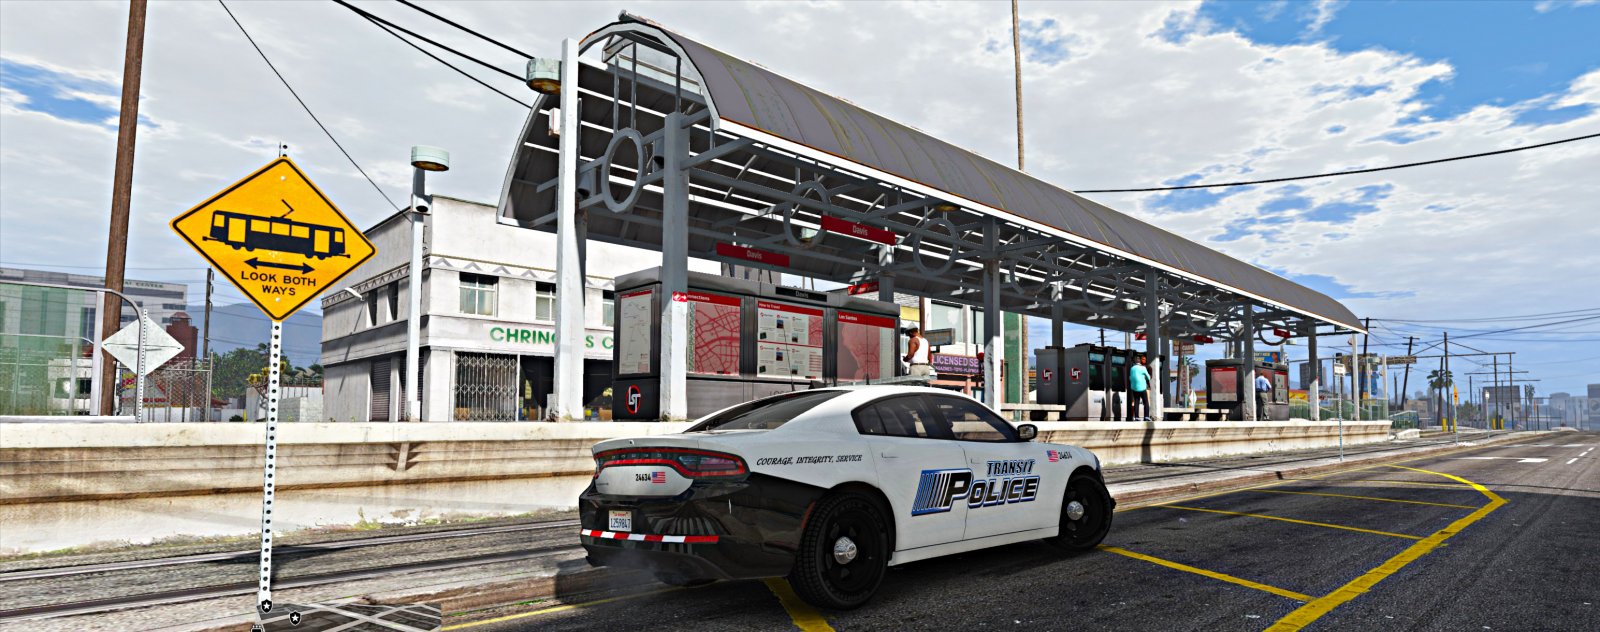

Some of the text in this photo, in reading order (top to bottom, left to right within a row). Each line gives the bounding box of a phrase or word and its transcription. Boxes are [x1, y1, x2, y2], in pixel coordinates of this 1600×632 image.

[852, 225, 869, 237] Davis
[746, 249, 763, 260] Davis
[241, 270, 316, 287] LOOK BOTH
[262, 284, 296, 296] WAYS
[795, 290, 809, 299] Davis
[687, 294, 710, 302] onnections
[934, 355, 969, 367] LICENSED
[756, 454, 863, 466] COURAGE, INTEGRITY, SERVICE
[986, 459, 1035, 477] TRANSIT
[635, 473, 651, 482] 24634
